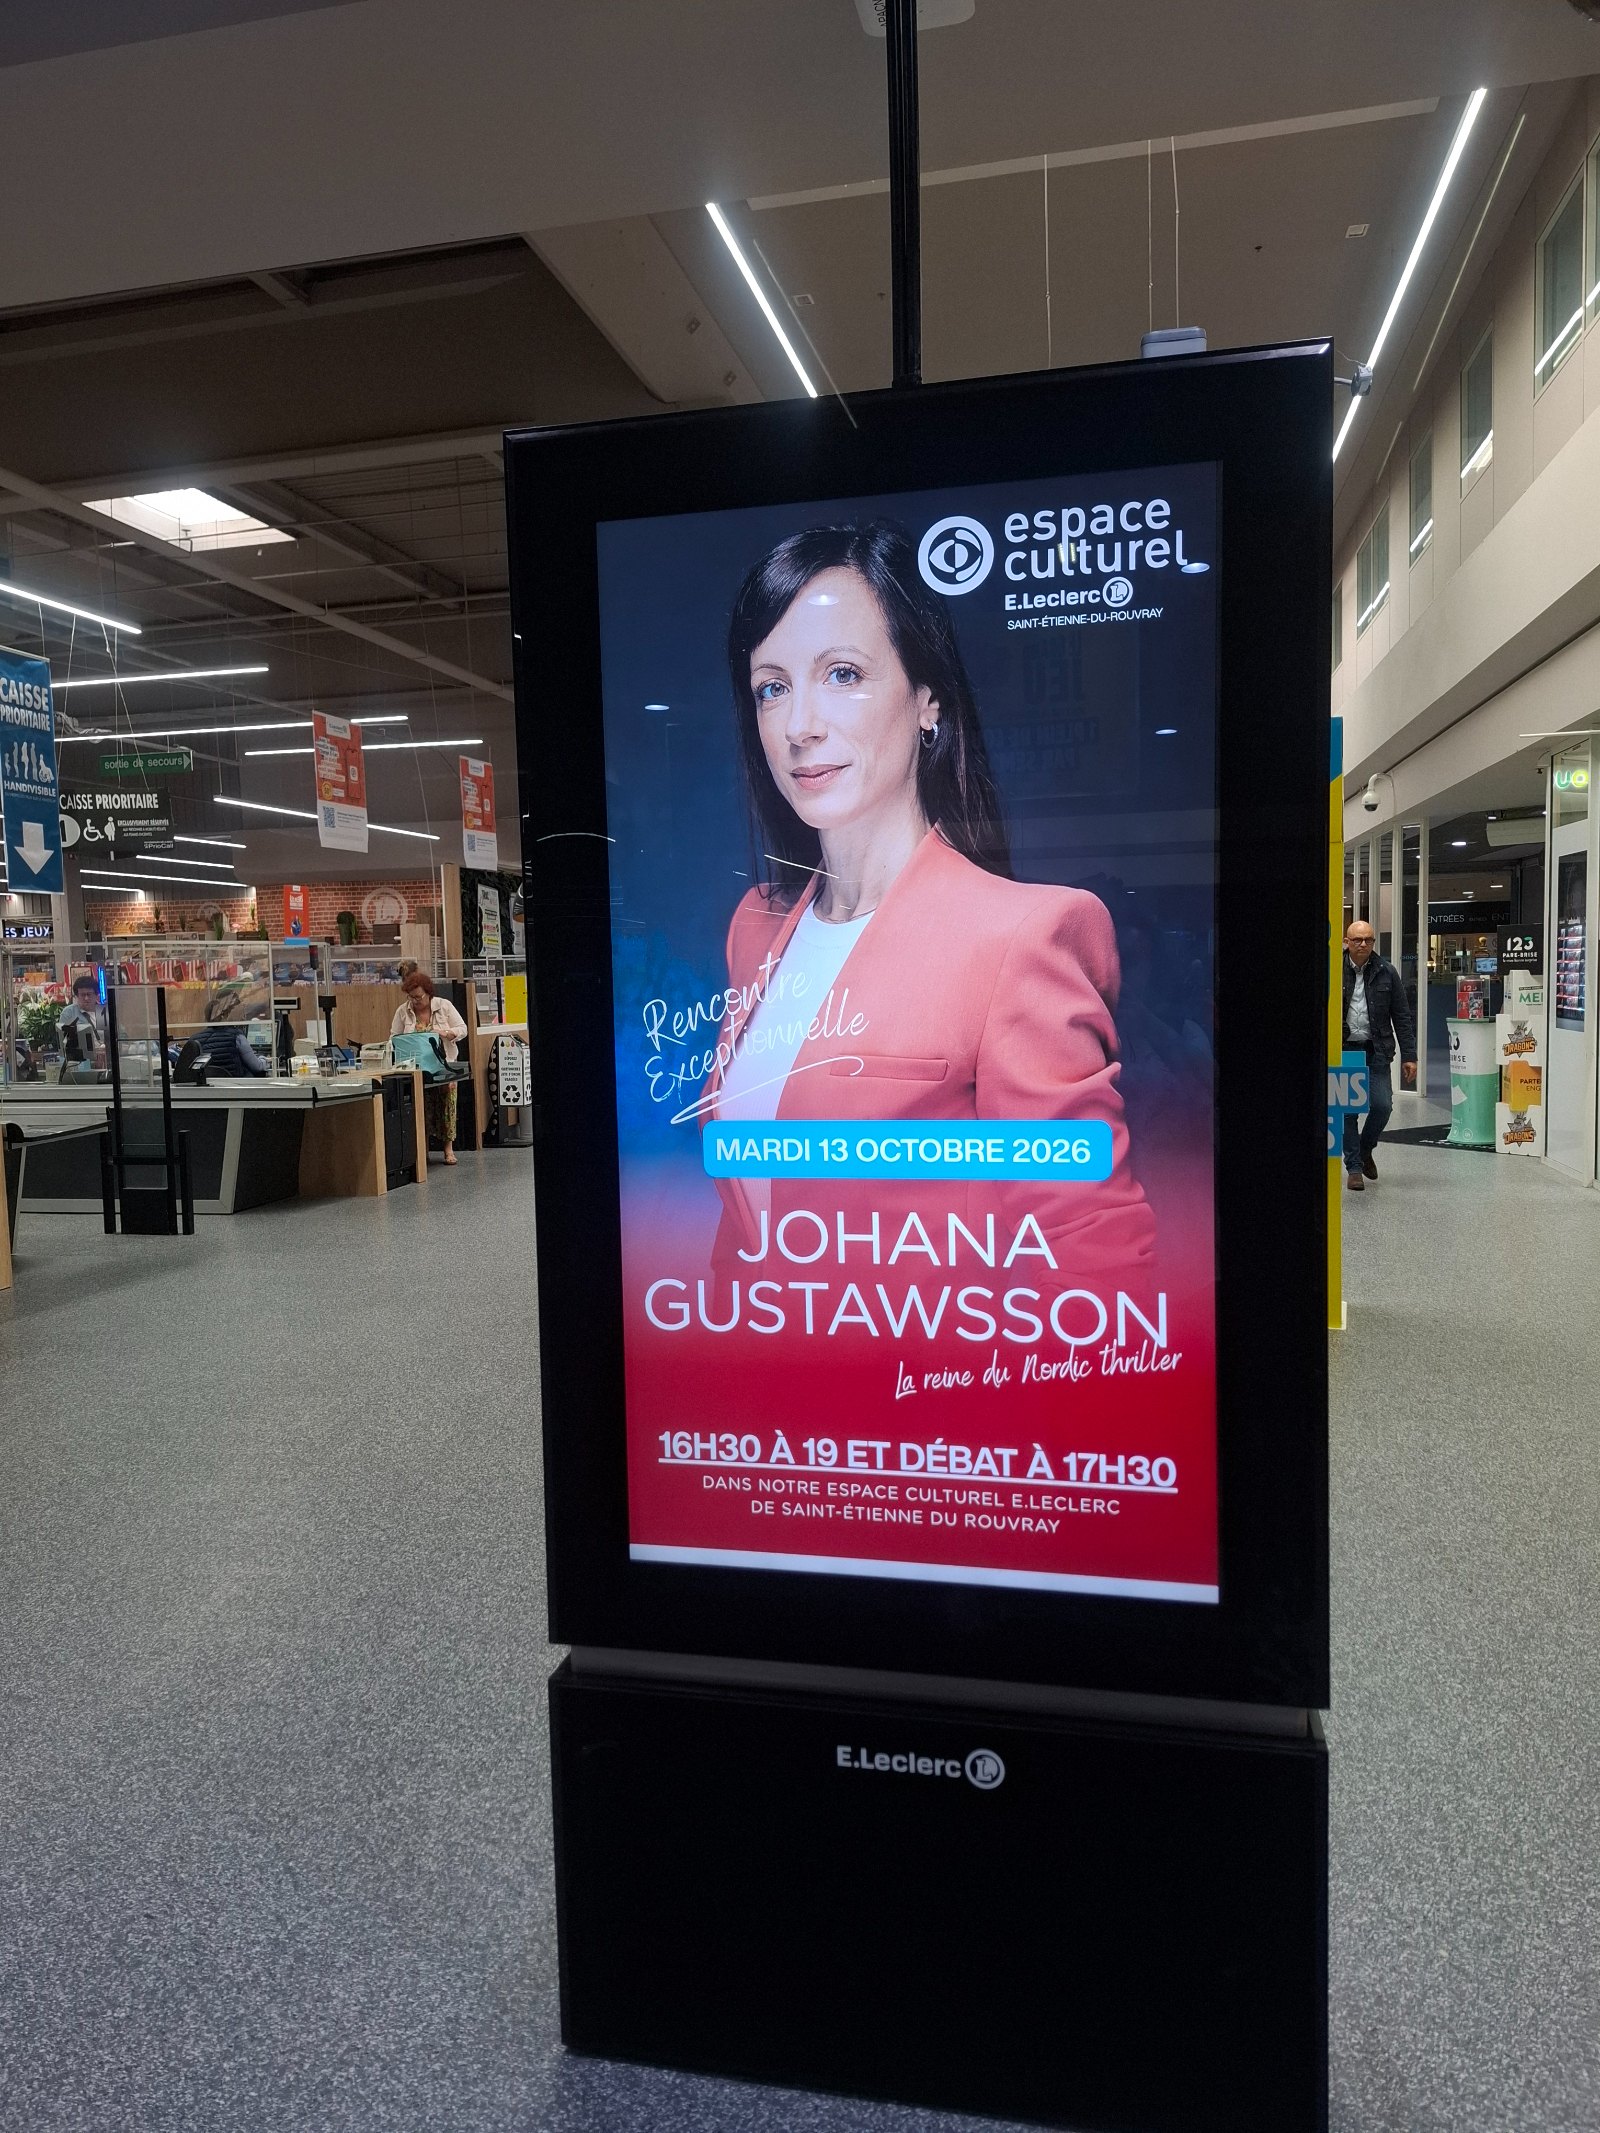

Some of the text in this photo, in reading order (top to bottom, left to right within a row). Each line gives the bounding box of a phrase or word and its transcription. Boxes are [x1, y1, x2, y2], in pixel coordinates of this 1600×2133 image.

[1004, 498, 1171, 543] espace
[1004, 529, 1188, 581] culturel
[1004, 587, 1101, 611] E.Leclerc
[1007, 607, 1164, 631] SAINT-ÉTIENNE-DU-ROUVRAY
[0, 677, 49, 712] CAISSE
[0, 704, 51, 732] PRIORITAIRE
[105, 757, 183, 770] sortie de secours
[4, 780, 56, 798] HANDIVISIBLE
[60, 794, 93, 810] CAISSE
[95, 793, 159, 810] PRIORITAIRE
[21, 926, 50, 938] JEUX
[1427, 914, 1465, 924] ENTRÉES
[1506, 936, 1534, 951] 123
[643, 951, 813, 1052] Rencontre
[1519, 992, 1543, 1003] ME
[644, 987, 870, 1104] Exceptionnelle
[1503, 1040, 1536, 1057] DRAGONS
[715, 1137, 1091, 1165] MARDI 13 OCTOBRE 2026
[1503, 1131, 1535, 1146] DRAGONS
[736, 1209, 1059, 1270] JOHANA
[643, 1277, 1169, 1349] GUSTAWSSON
[895, 1339, 1183, 1399] La reine du Nordic thriller
[658, 1429, 1178, 1488] 16H30 À 19 ET DÉBAT À 17H30
[702, 1475, 1121, 1515] DANS NOTRE ESPACE CULTUREL E.LECLERC
[750, 1499, 1061, 1535] DE SAINT-ÉTIENNE DU ROUVRAY
[836, 1744, 962, 1779] E.Leclerc
